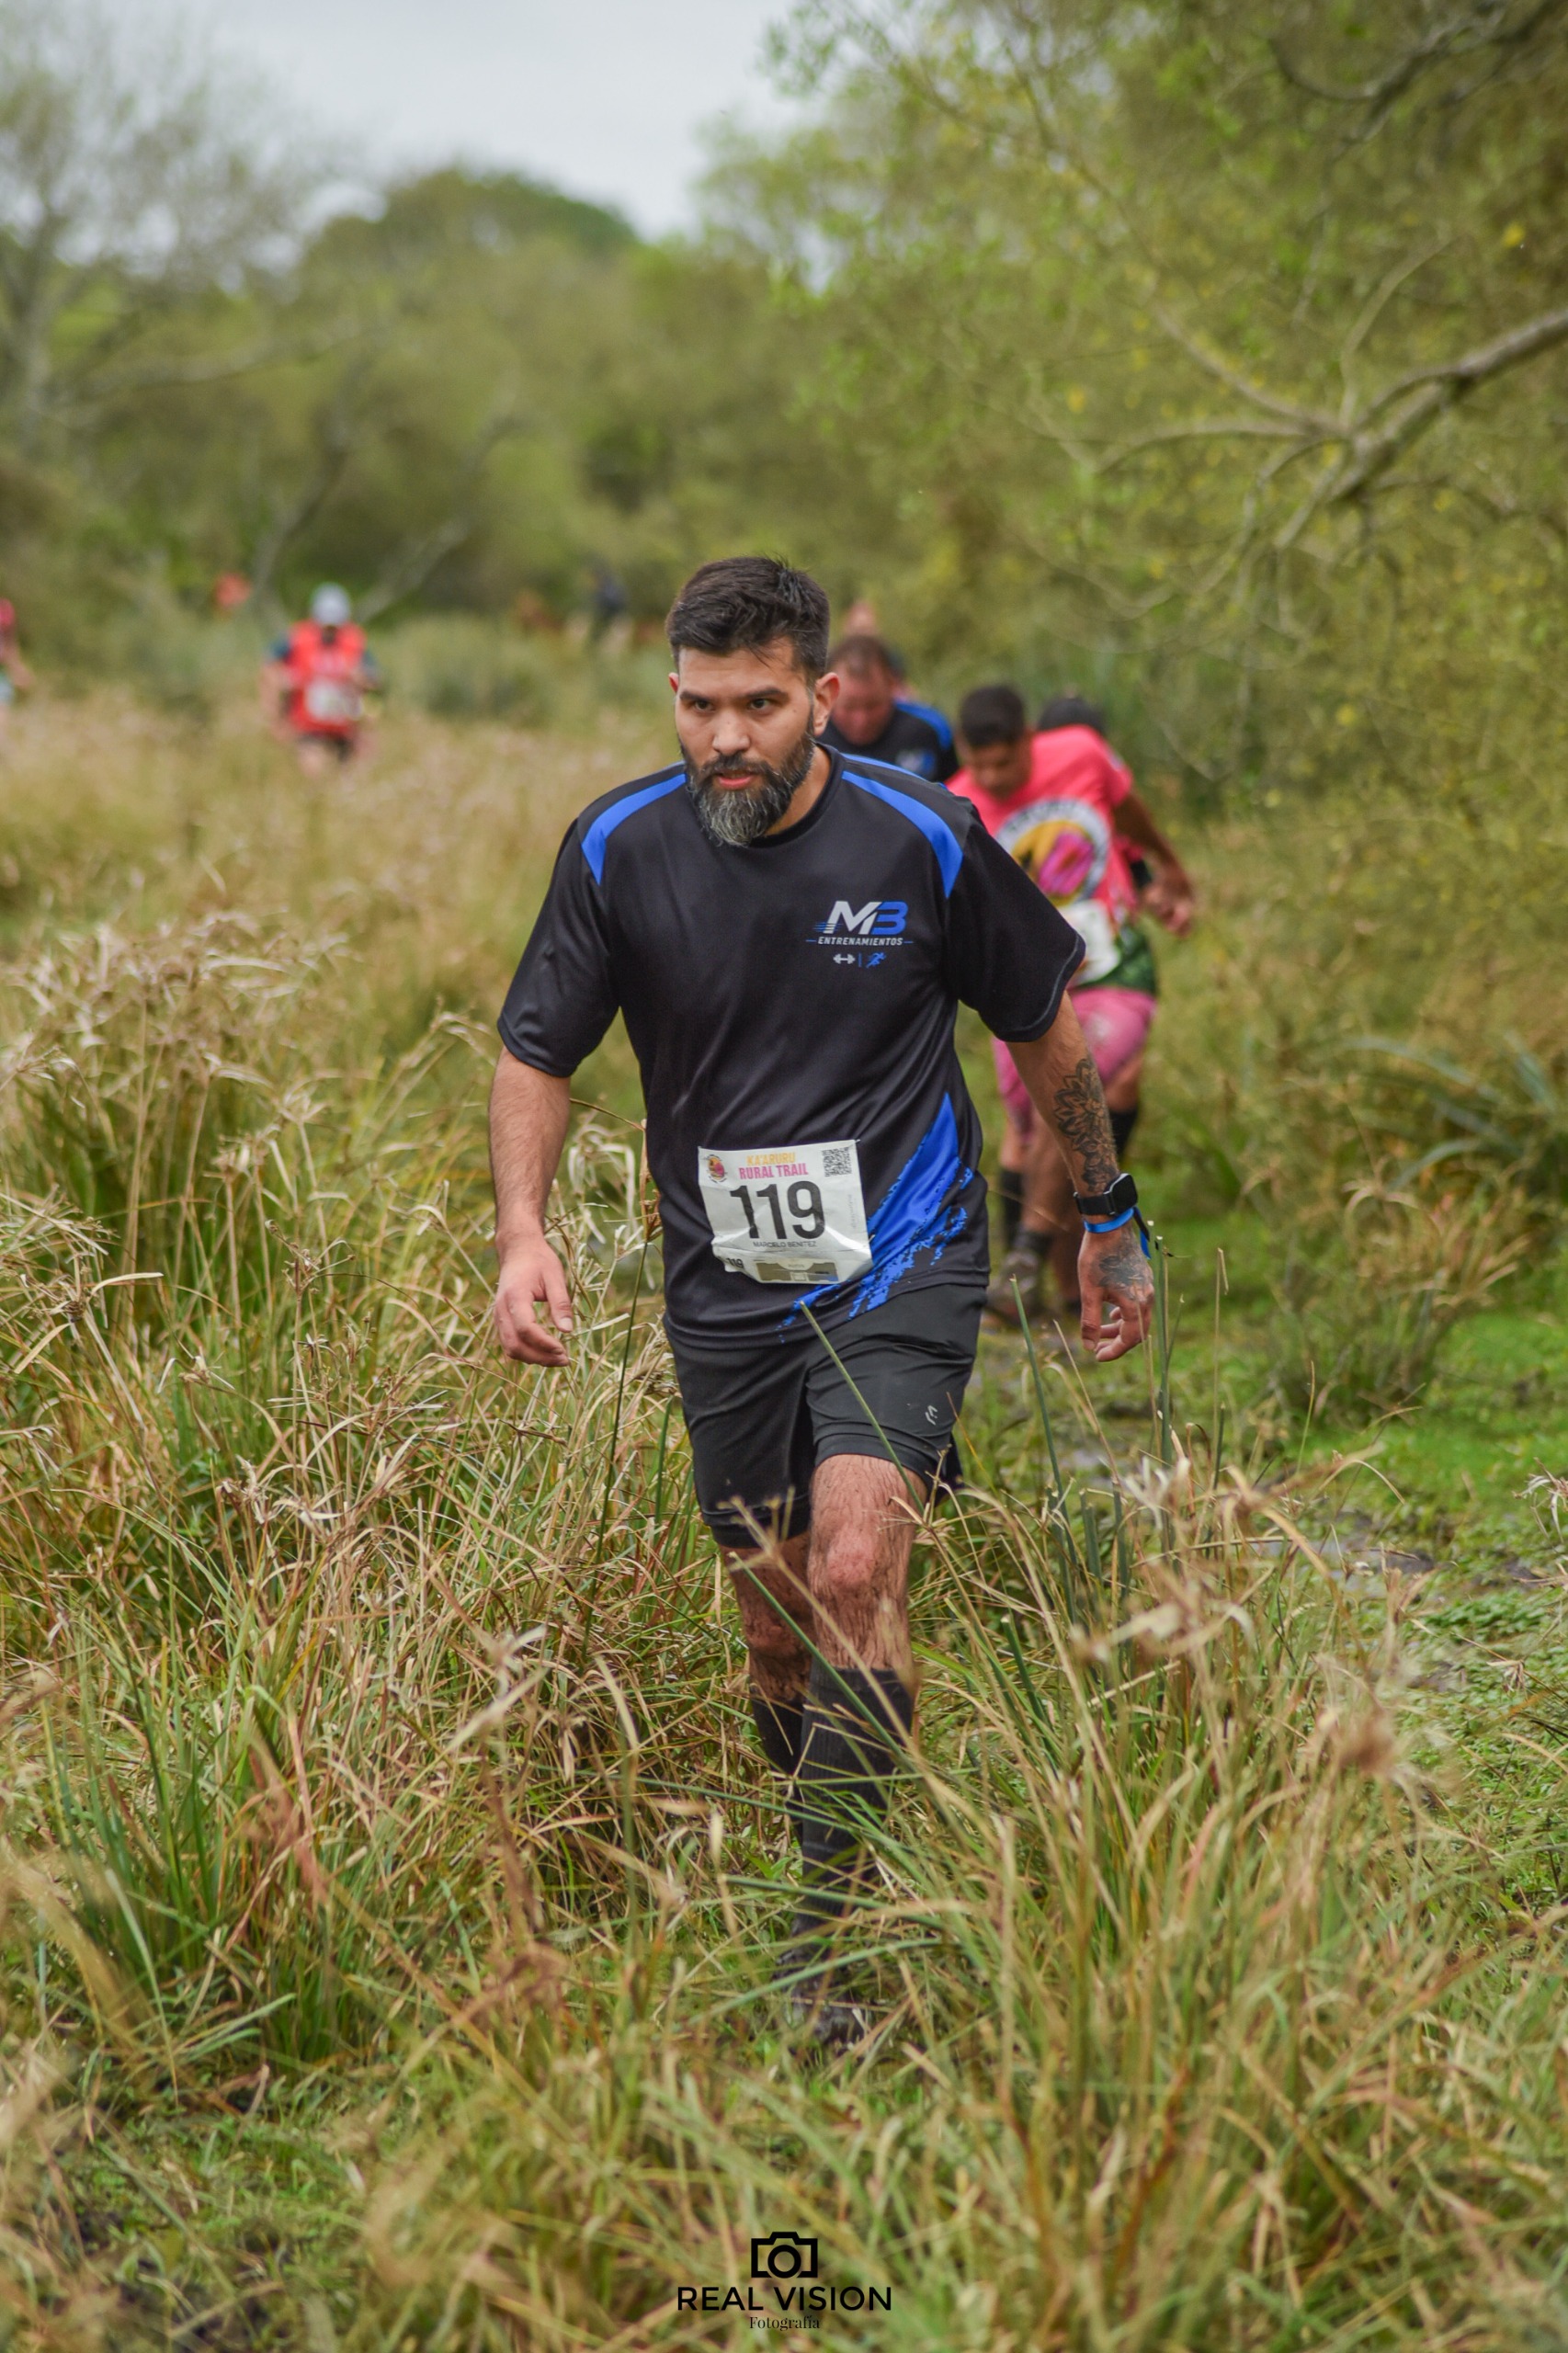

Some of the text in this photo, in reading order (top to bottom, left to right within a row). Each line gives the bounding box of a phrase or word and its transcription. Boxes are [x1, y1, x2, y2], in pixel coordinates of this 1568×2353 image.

[823, 901, 908, 935] MB
[818, 937, 903, 946] ENTRENAMIENTOS
[746, 1153, 795, 1165] KA'ARURU
[739, 1164, 809, 1179] RURAL TRAIL
[730, 1180, 825, 1239] 119
